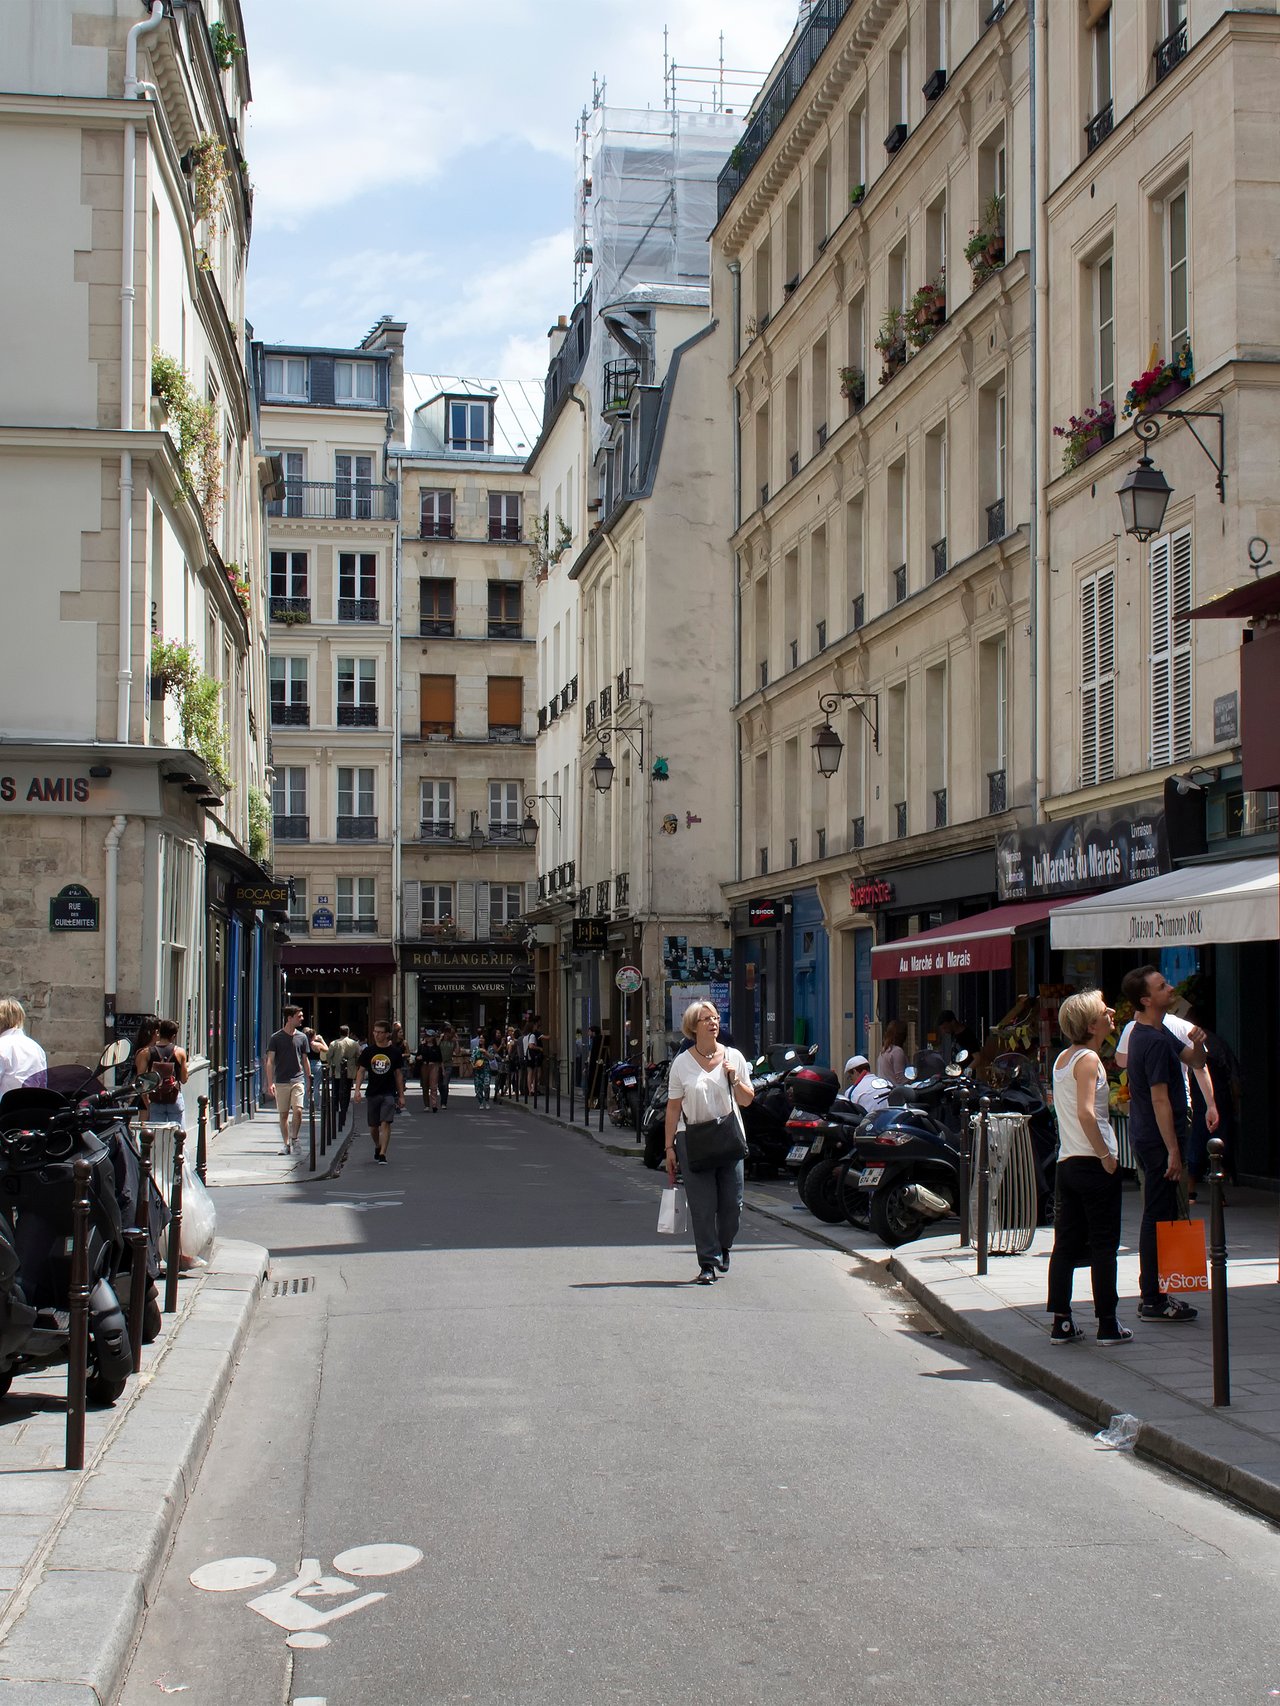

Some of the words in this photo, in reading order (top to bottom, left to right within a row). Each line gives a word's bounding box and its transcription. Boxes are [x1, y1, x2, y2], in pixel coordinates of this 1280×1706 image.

[0, 776, 17, 802] S
[26, 777, 90, 802] AMIS
[1130, 822, 1153, 838] Livraison
[1135, 843, 1155, 861] domicile
[1032, 855, 1043, 887] Au
[1043, 848, 1075, 885] Marché
[1076, 847, 1088, 880] du
[1088, 839, 1121, 878] Marais
[236, 888, 287, 900] BOCAGE
[68, 902, 81, 910] RUE
[54, 918, 95, 927] GUILLEMITES
[413, 953, 514, 965] BOULANGERIE
[899, 957, 909, 973] Au
[911, 953, 932, 971] Marché
[935, 953, 944, 969] du
[947, 949, 971, 968] Marais
[471, 983, 505, 991] SAVEURS
